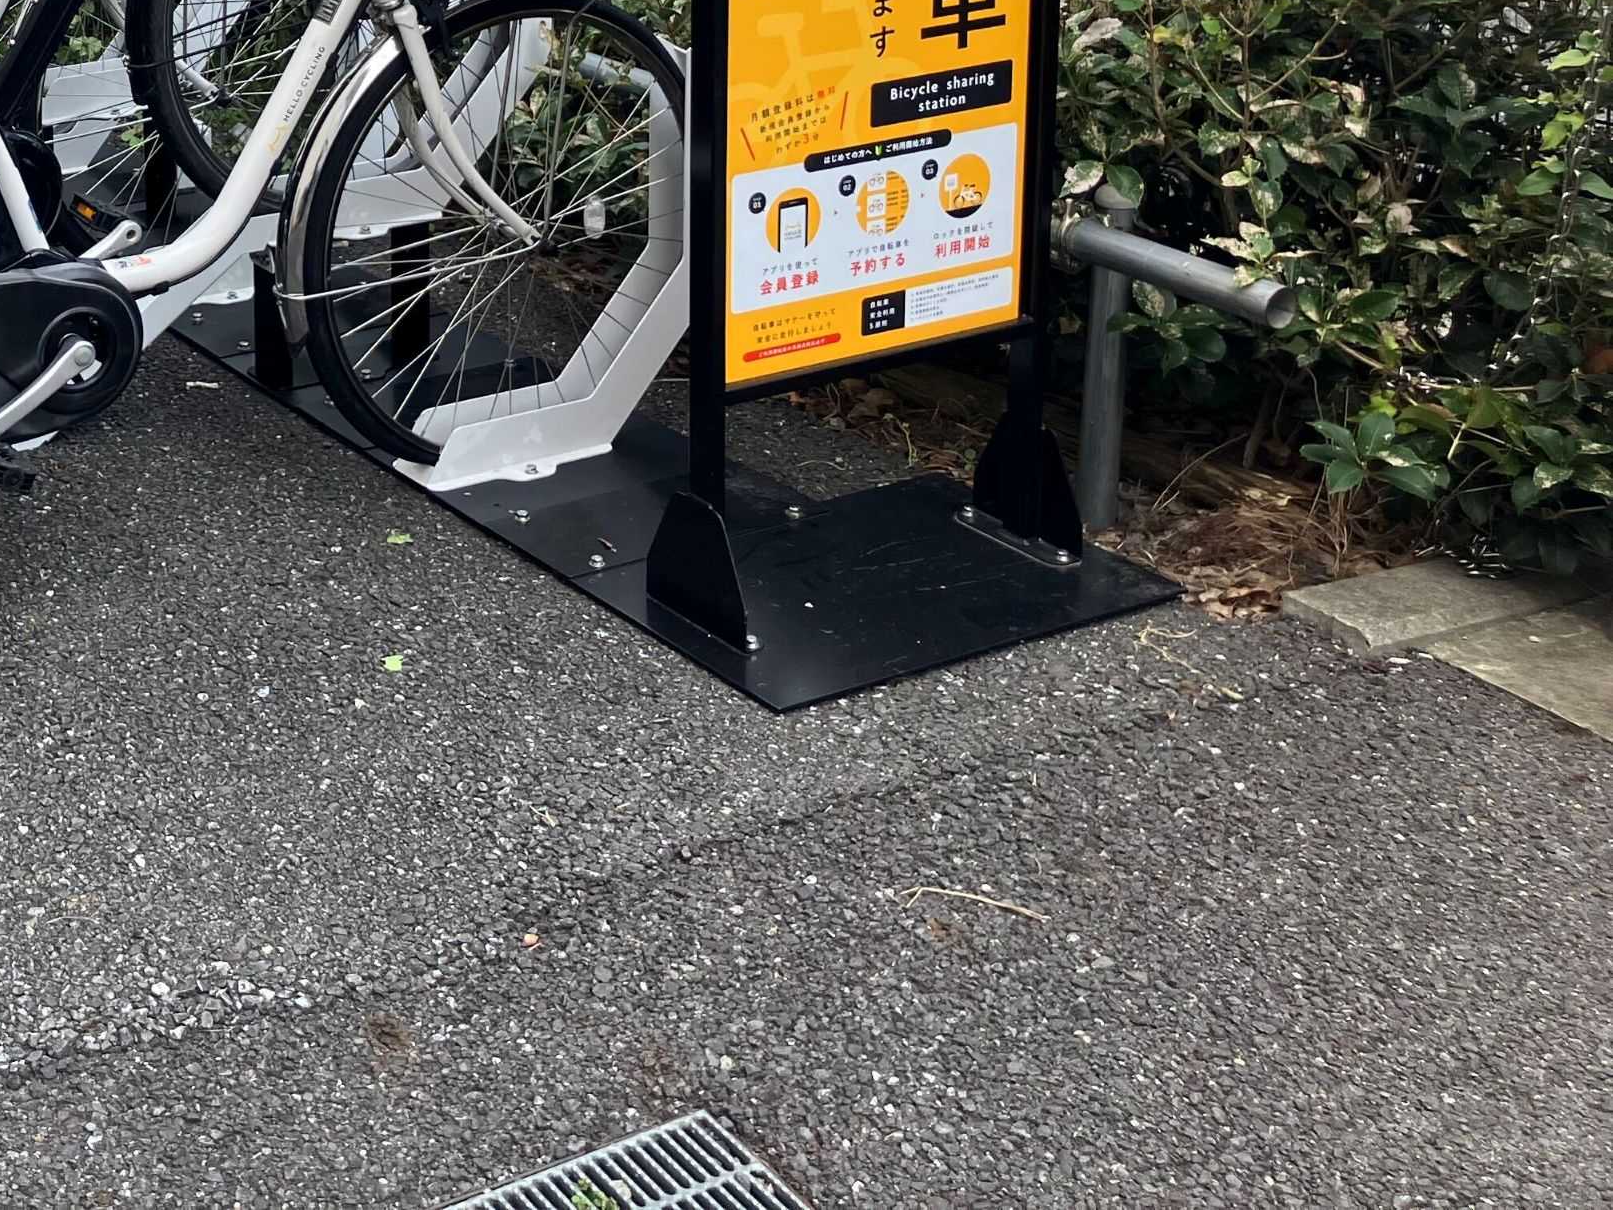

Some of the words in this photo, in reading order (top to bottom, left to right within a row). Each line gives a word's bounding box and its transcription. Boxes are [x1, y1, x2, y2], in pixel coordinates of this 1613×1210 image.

[283, 89, 304, 121] HELLO
[301, 45, 326, 87] CYCLING
[890, 81, 939, 100] Bicycle
[947, 73, 995, 91] sharing
[918, 94, 967, 112] station
[934, 235, 991, 258] 利用開始
[850, 253, 906, 277] 予約する
[760, 270, 820, 295] 会員登録
